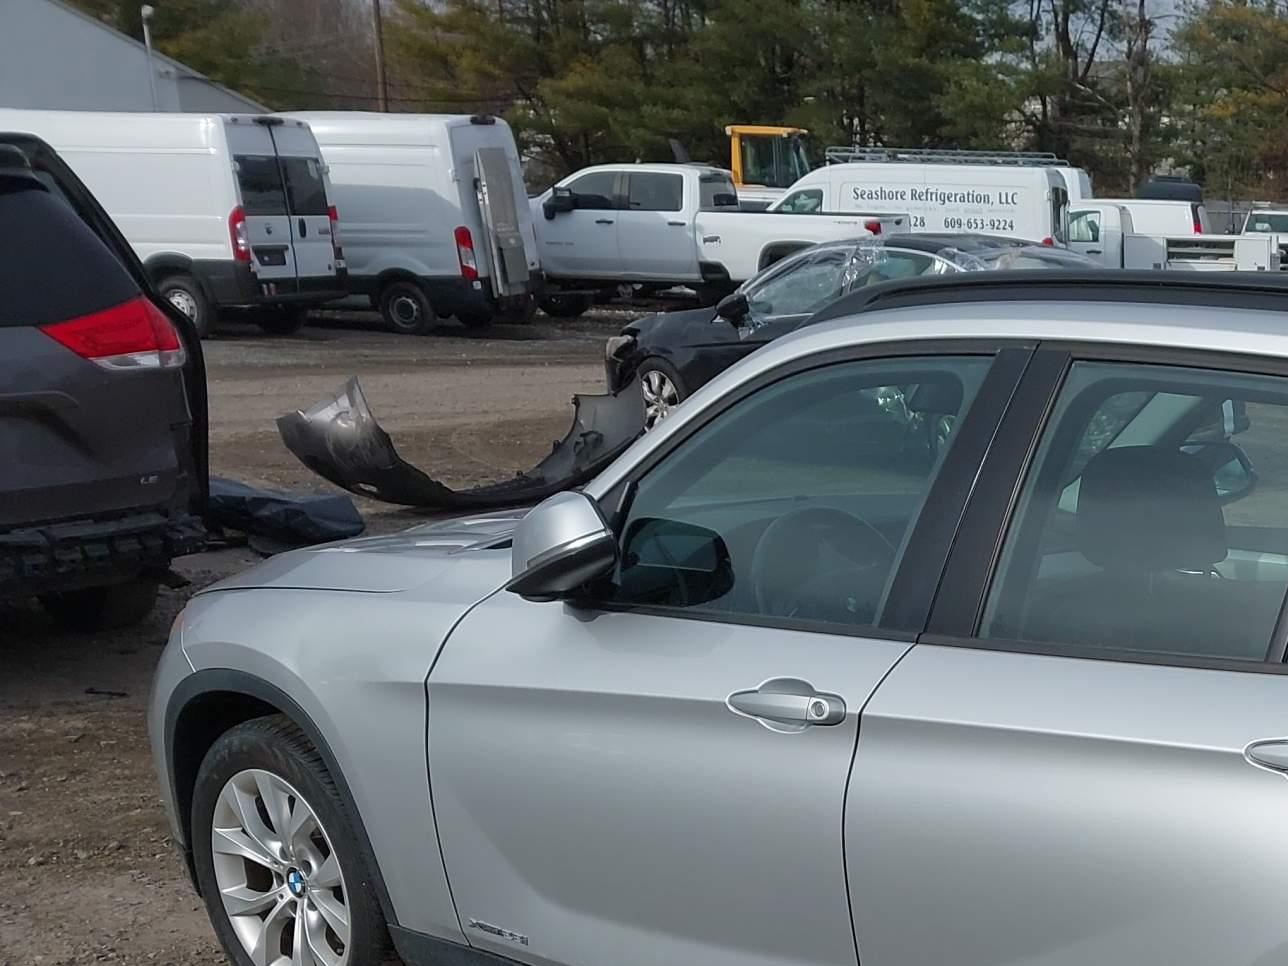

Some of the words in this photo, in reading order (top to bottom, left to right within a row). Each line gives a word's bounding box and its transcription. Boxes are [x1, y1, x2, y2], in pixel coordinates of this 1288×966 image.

[853, 186, 906, 201] Seashore
[910, 187, 994, 205] Refrigeration,
[998, 191, 1018, 205] LLC
[943, 216, 1014, 231] 609-653-9224
